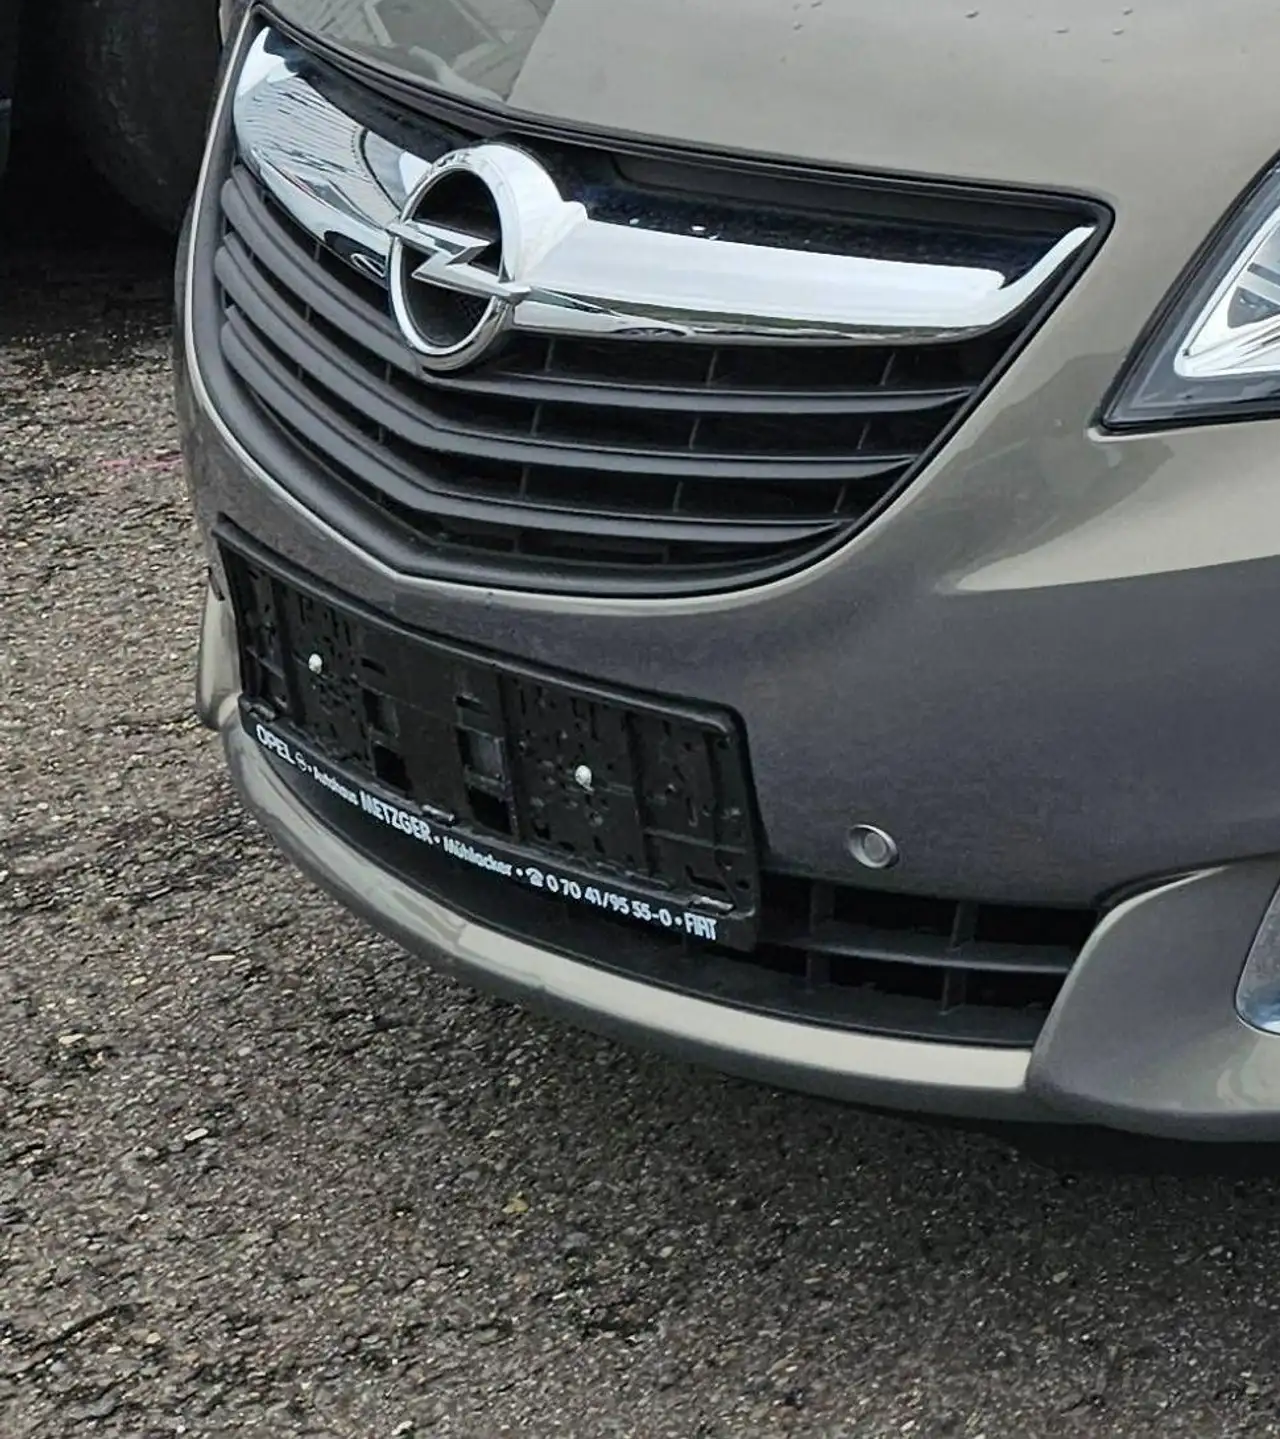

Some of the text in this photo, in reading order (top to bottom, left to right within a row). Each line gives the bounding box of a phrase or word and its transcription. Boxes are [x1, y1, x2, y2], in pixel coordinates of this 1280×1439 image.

[256, 723, 297, 765] OPEL
[359, 789, 434, 845] METZGER
[684, 911, 718, 941] FIAT
